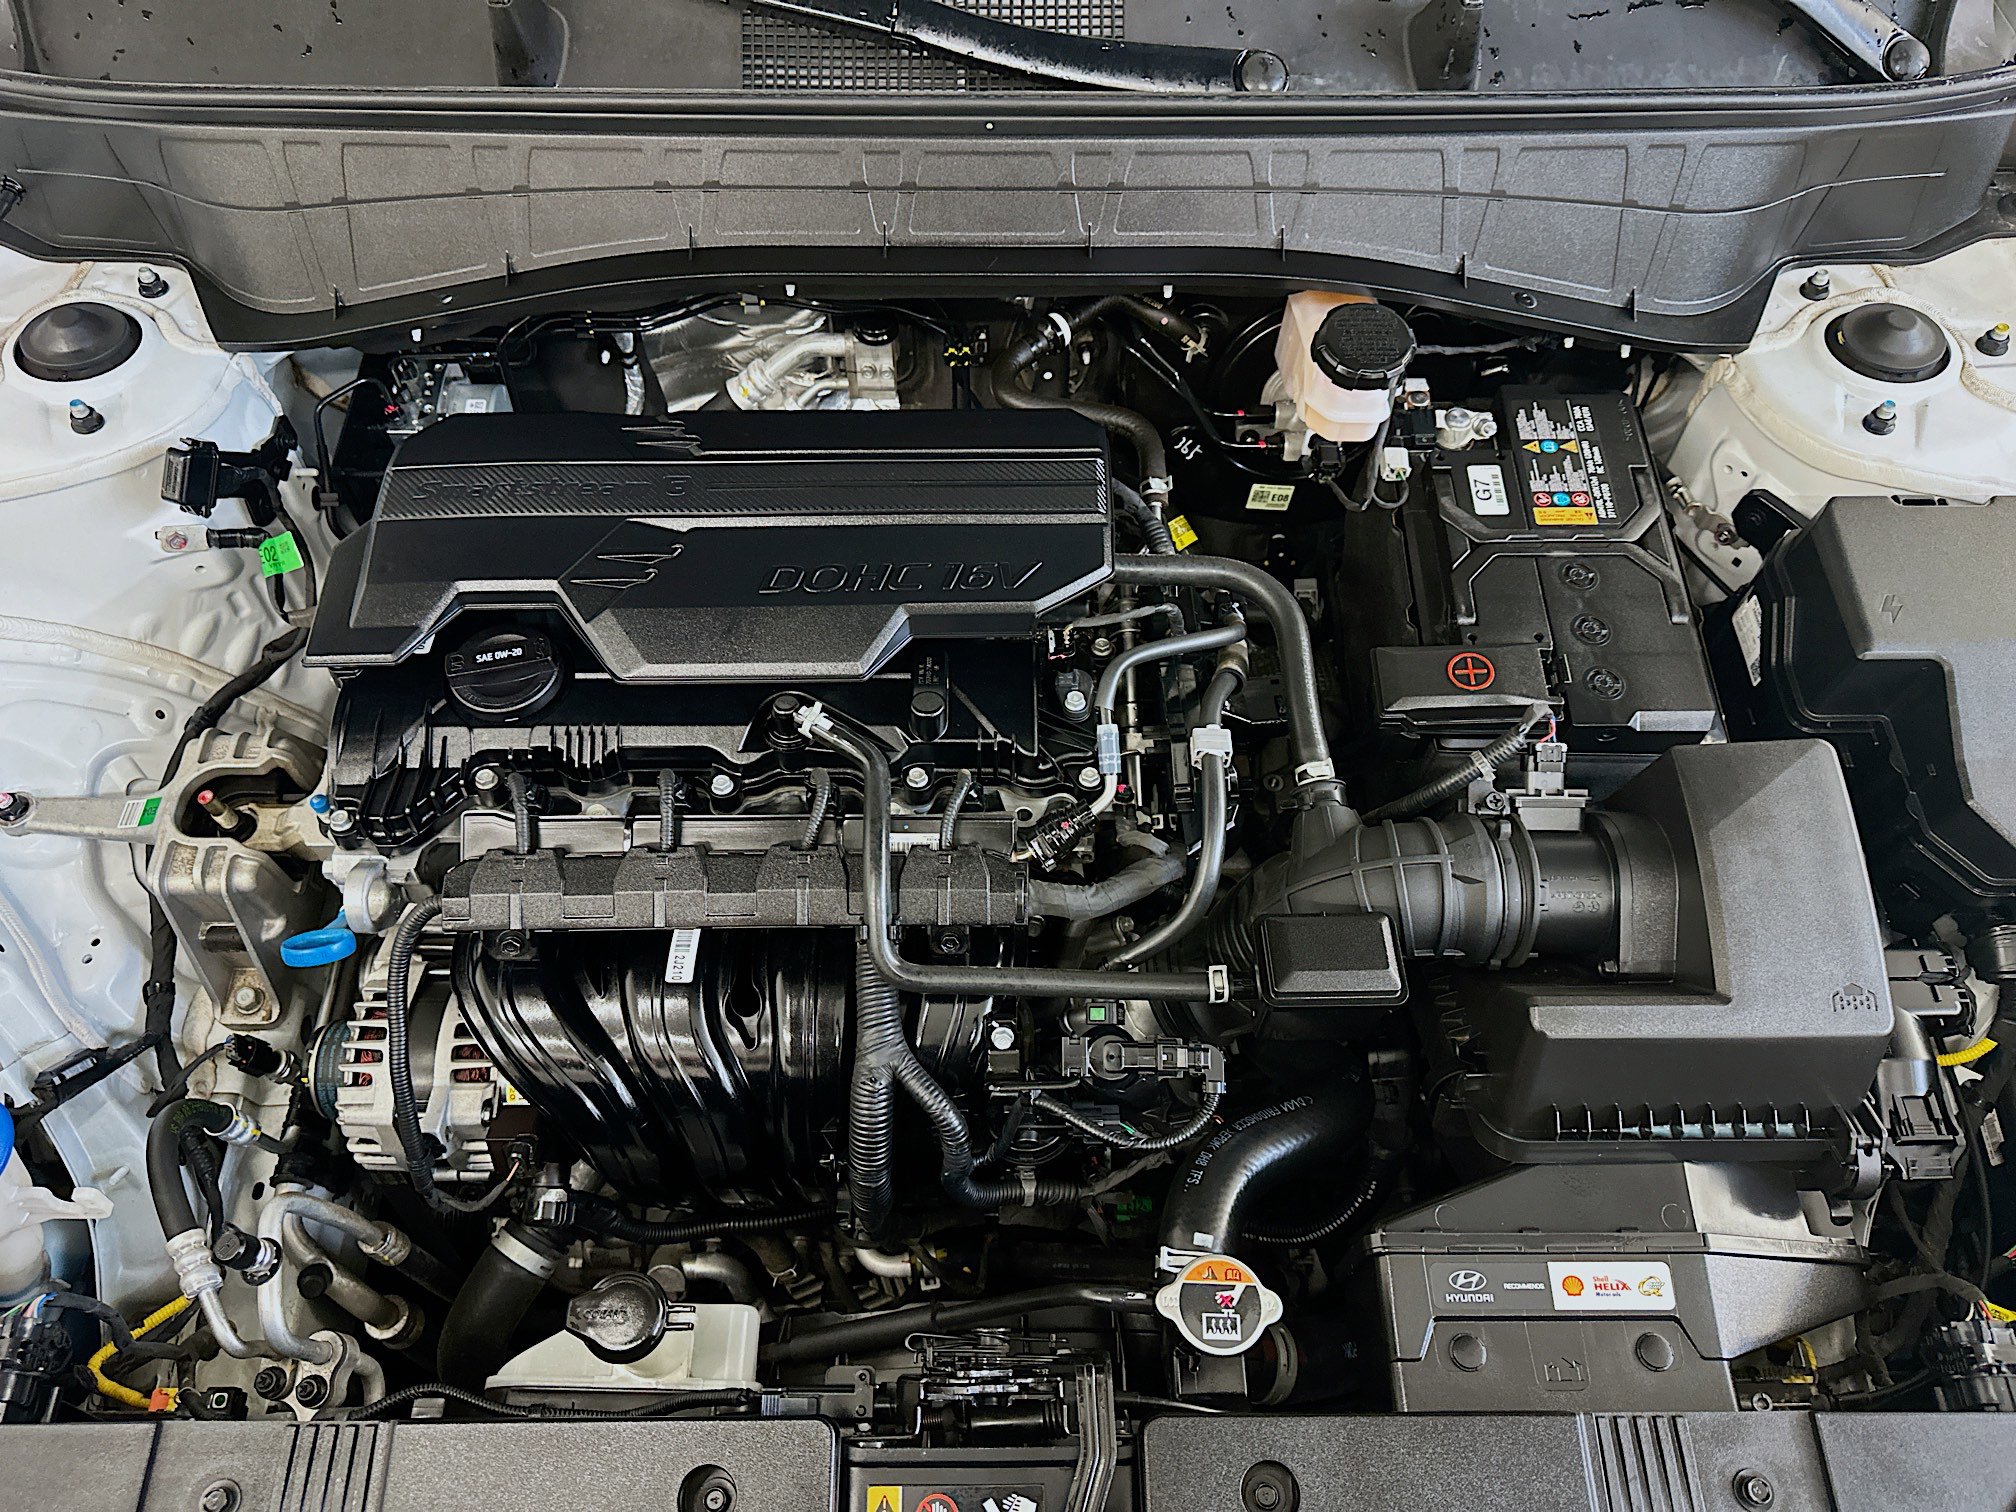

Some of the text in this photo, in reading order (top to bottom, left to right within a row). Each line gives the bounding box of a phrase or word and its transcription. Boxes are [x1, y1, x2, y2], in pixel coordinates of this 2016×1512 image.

[1173, 436, 1203, 460] 365
[1271, 493, 1290, 502] E08
[1474, 479, 1493, 502] G7
[263, 545, 279, 562] 02
[758, 561, 1043, 594] DOHC 16V
[475, 652, 494, 664] SAE
[494, 647, 523, 660] 0W-20
[671, 954, 686, 981] 2J210
[1503, 1282, 1546, 1290] RECOMMENDS
[1592, 1275, 1609, 1283] Shell
[1594, 1280, 1632, 1291] HELIX
[1445, 1293, 1495, 1303] HYUNDAI
